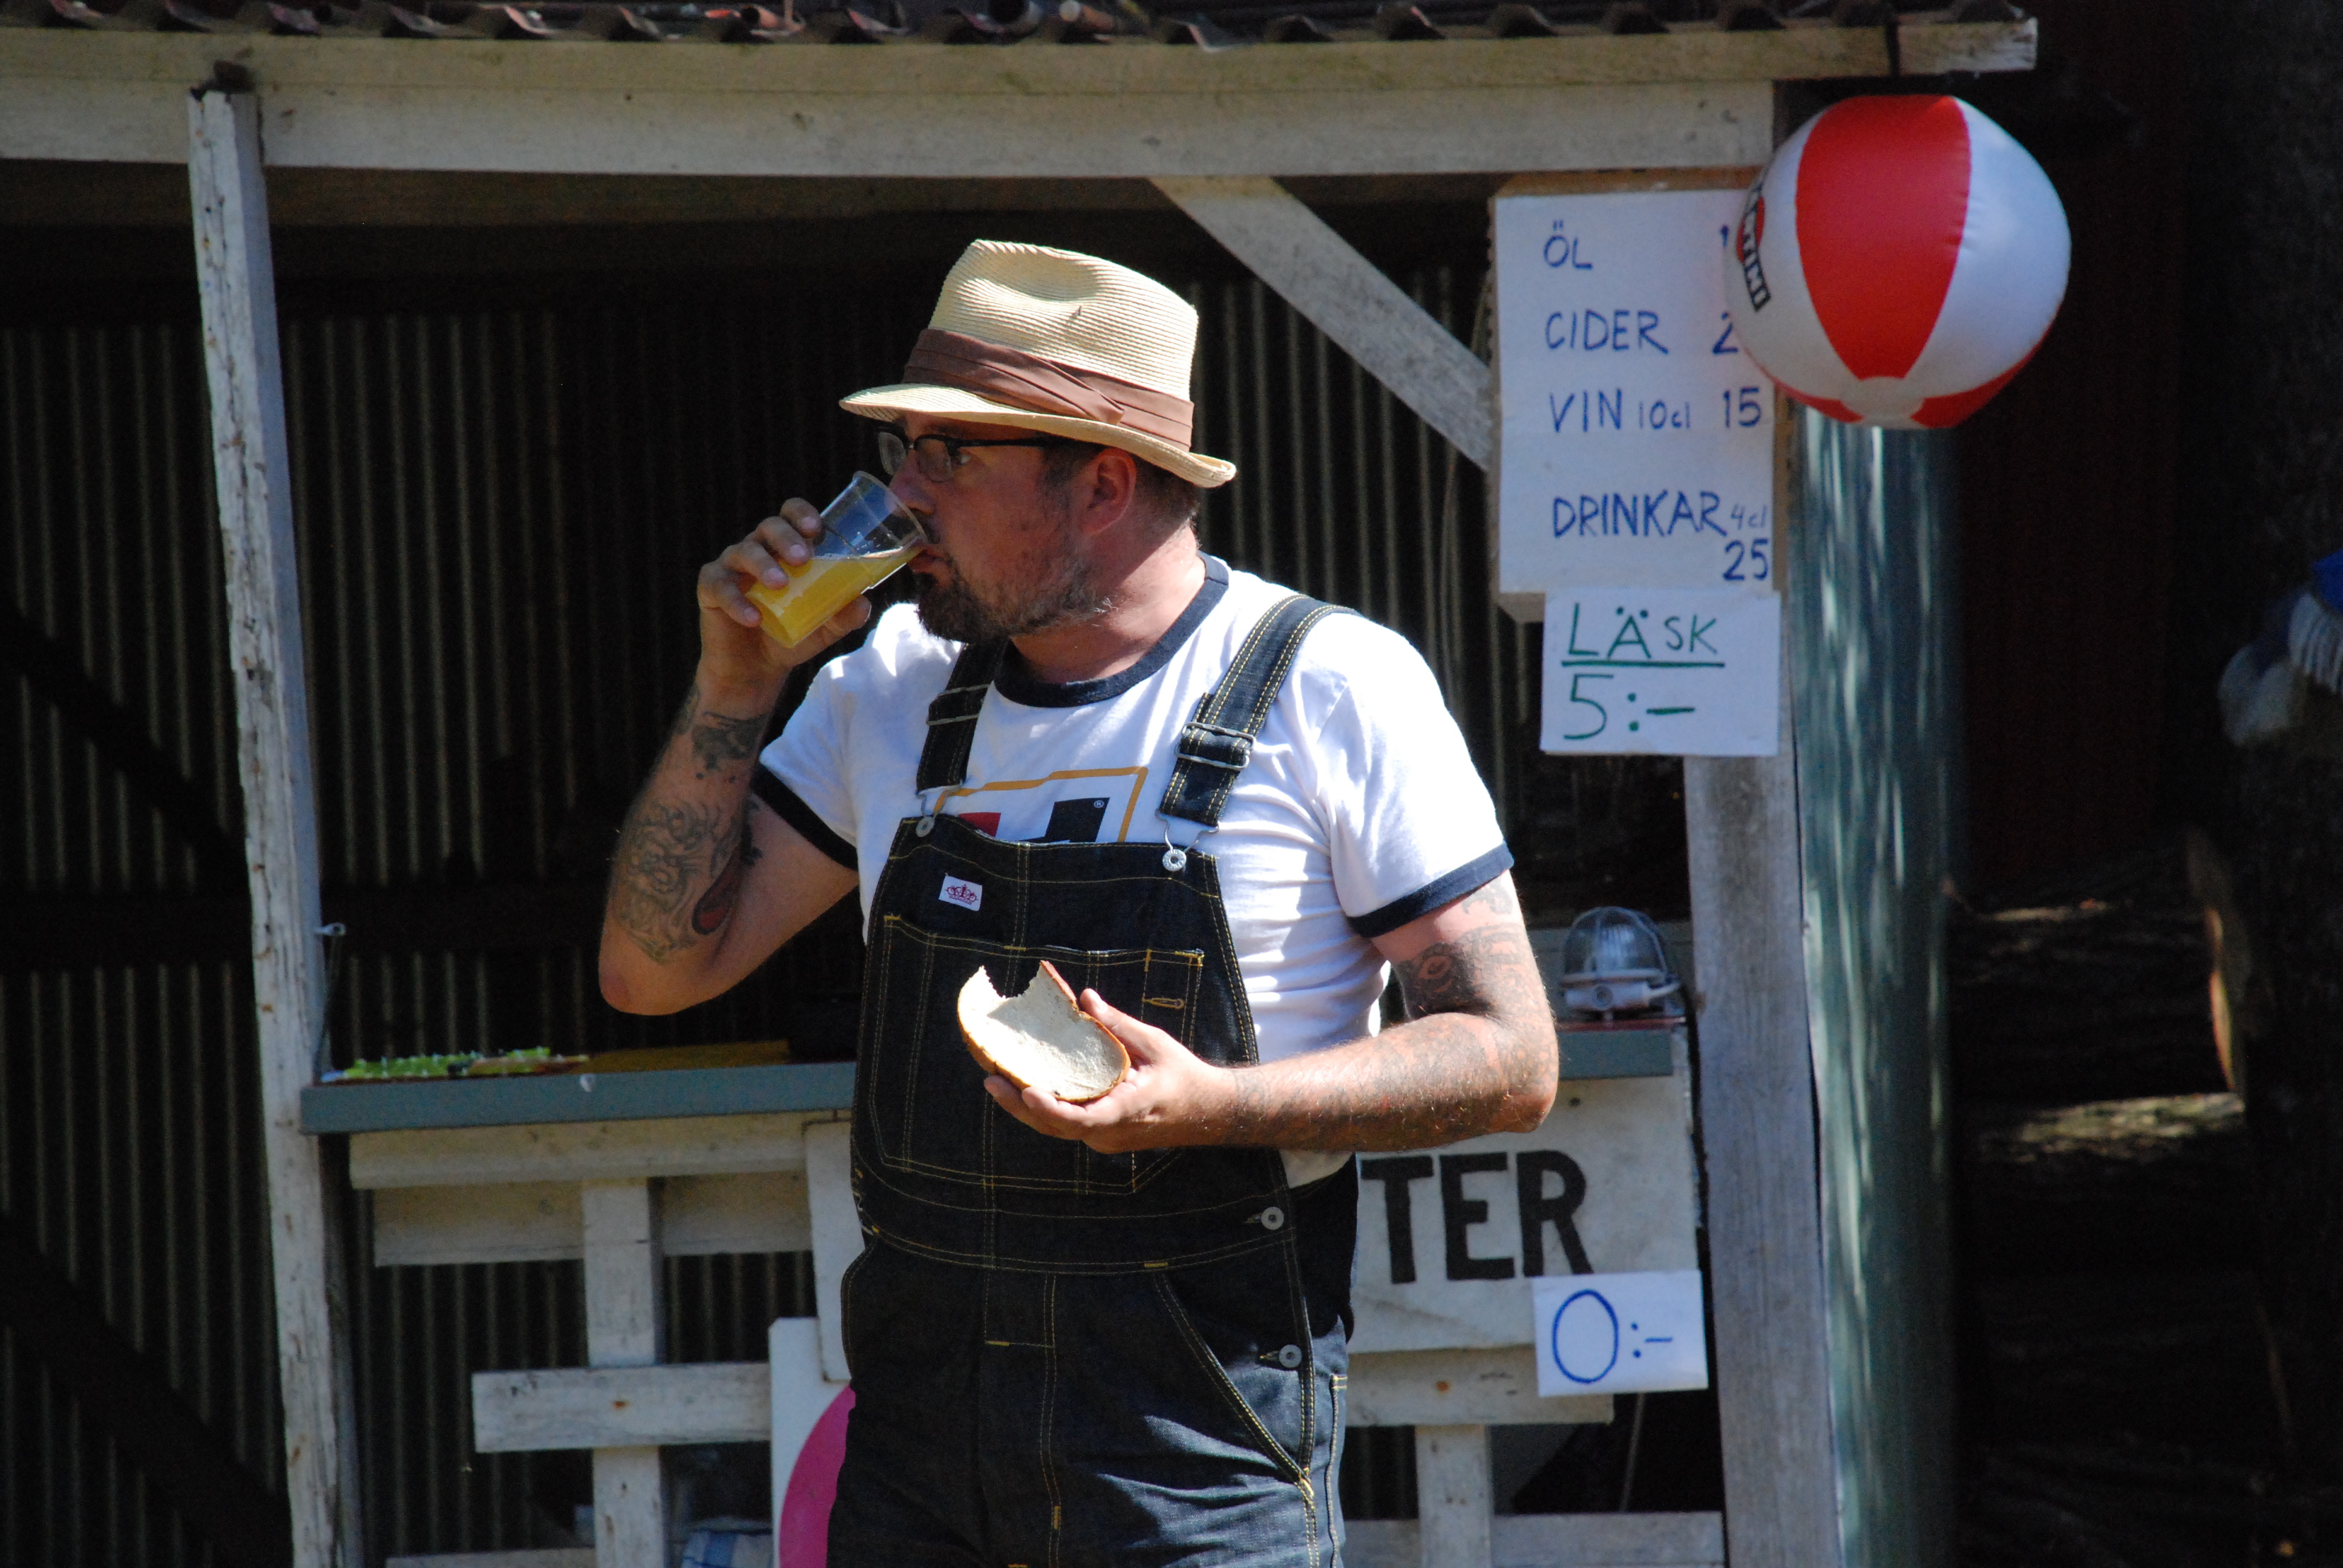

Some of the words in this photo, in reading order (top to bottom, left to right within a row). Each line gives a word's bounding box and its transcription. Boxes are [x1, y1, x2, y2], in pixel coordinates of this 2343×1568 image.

[1544, 221, 1593, 270] ÖL
[1545, 310, 1669, 355] CIDER
[1550, 388, 1623, 433] VIN
[1723, 387, 1762, 428] 15
[1553, 490, 1727, 538] DRINKAR
[1730, 504, 1768, 531] 4cl
[1722, 538, 1768, 581] 25
[1568, 603, 1717, 658] LÄSK
[1564, 673, 1696, 740] 5:-
[1360, 1149, 1594, 1284] TER
